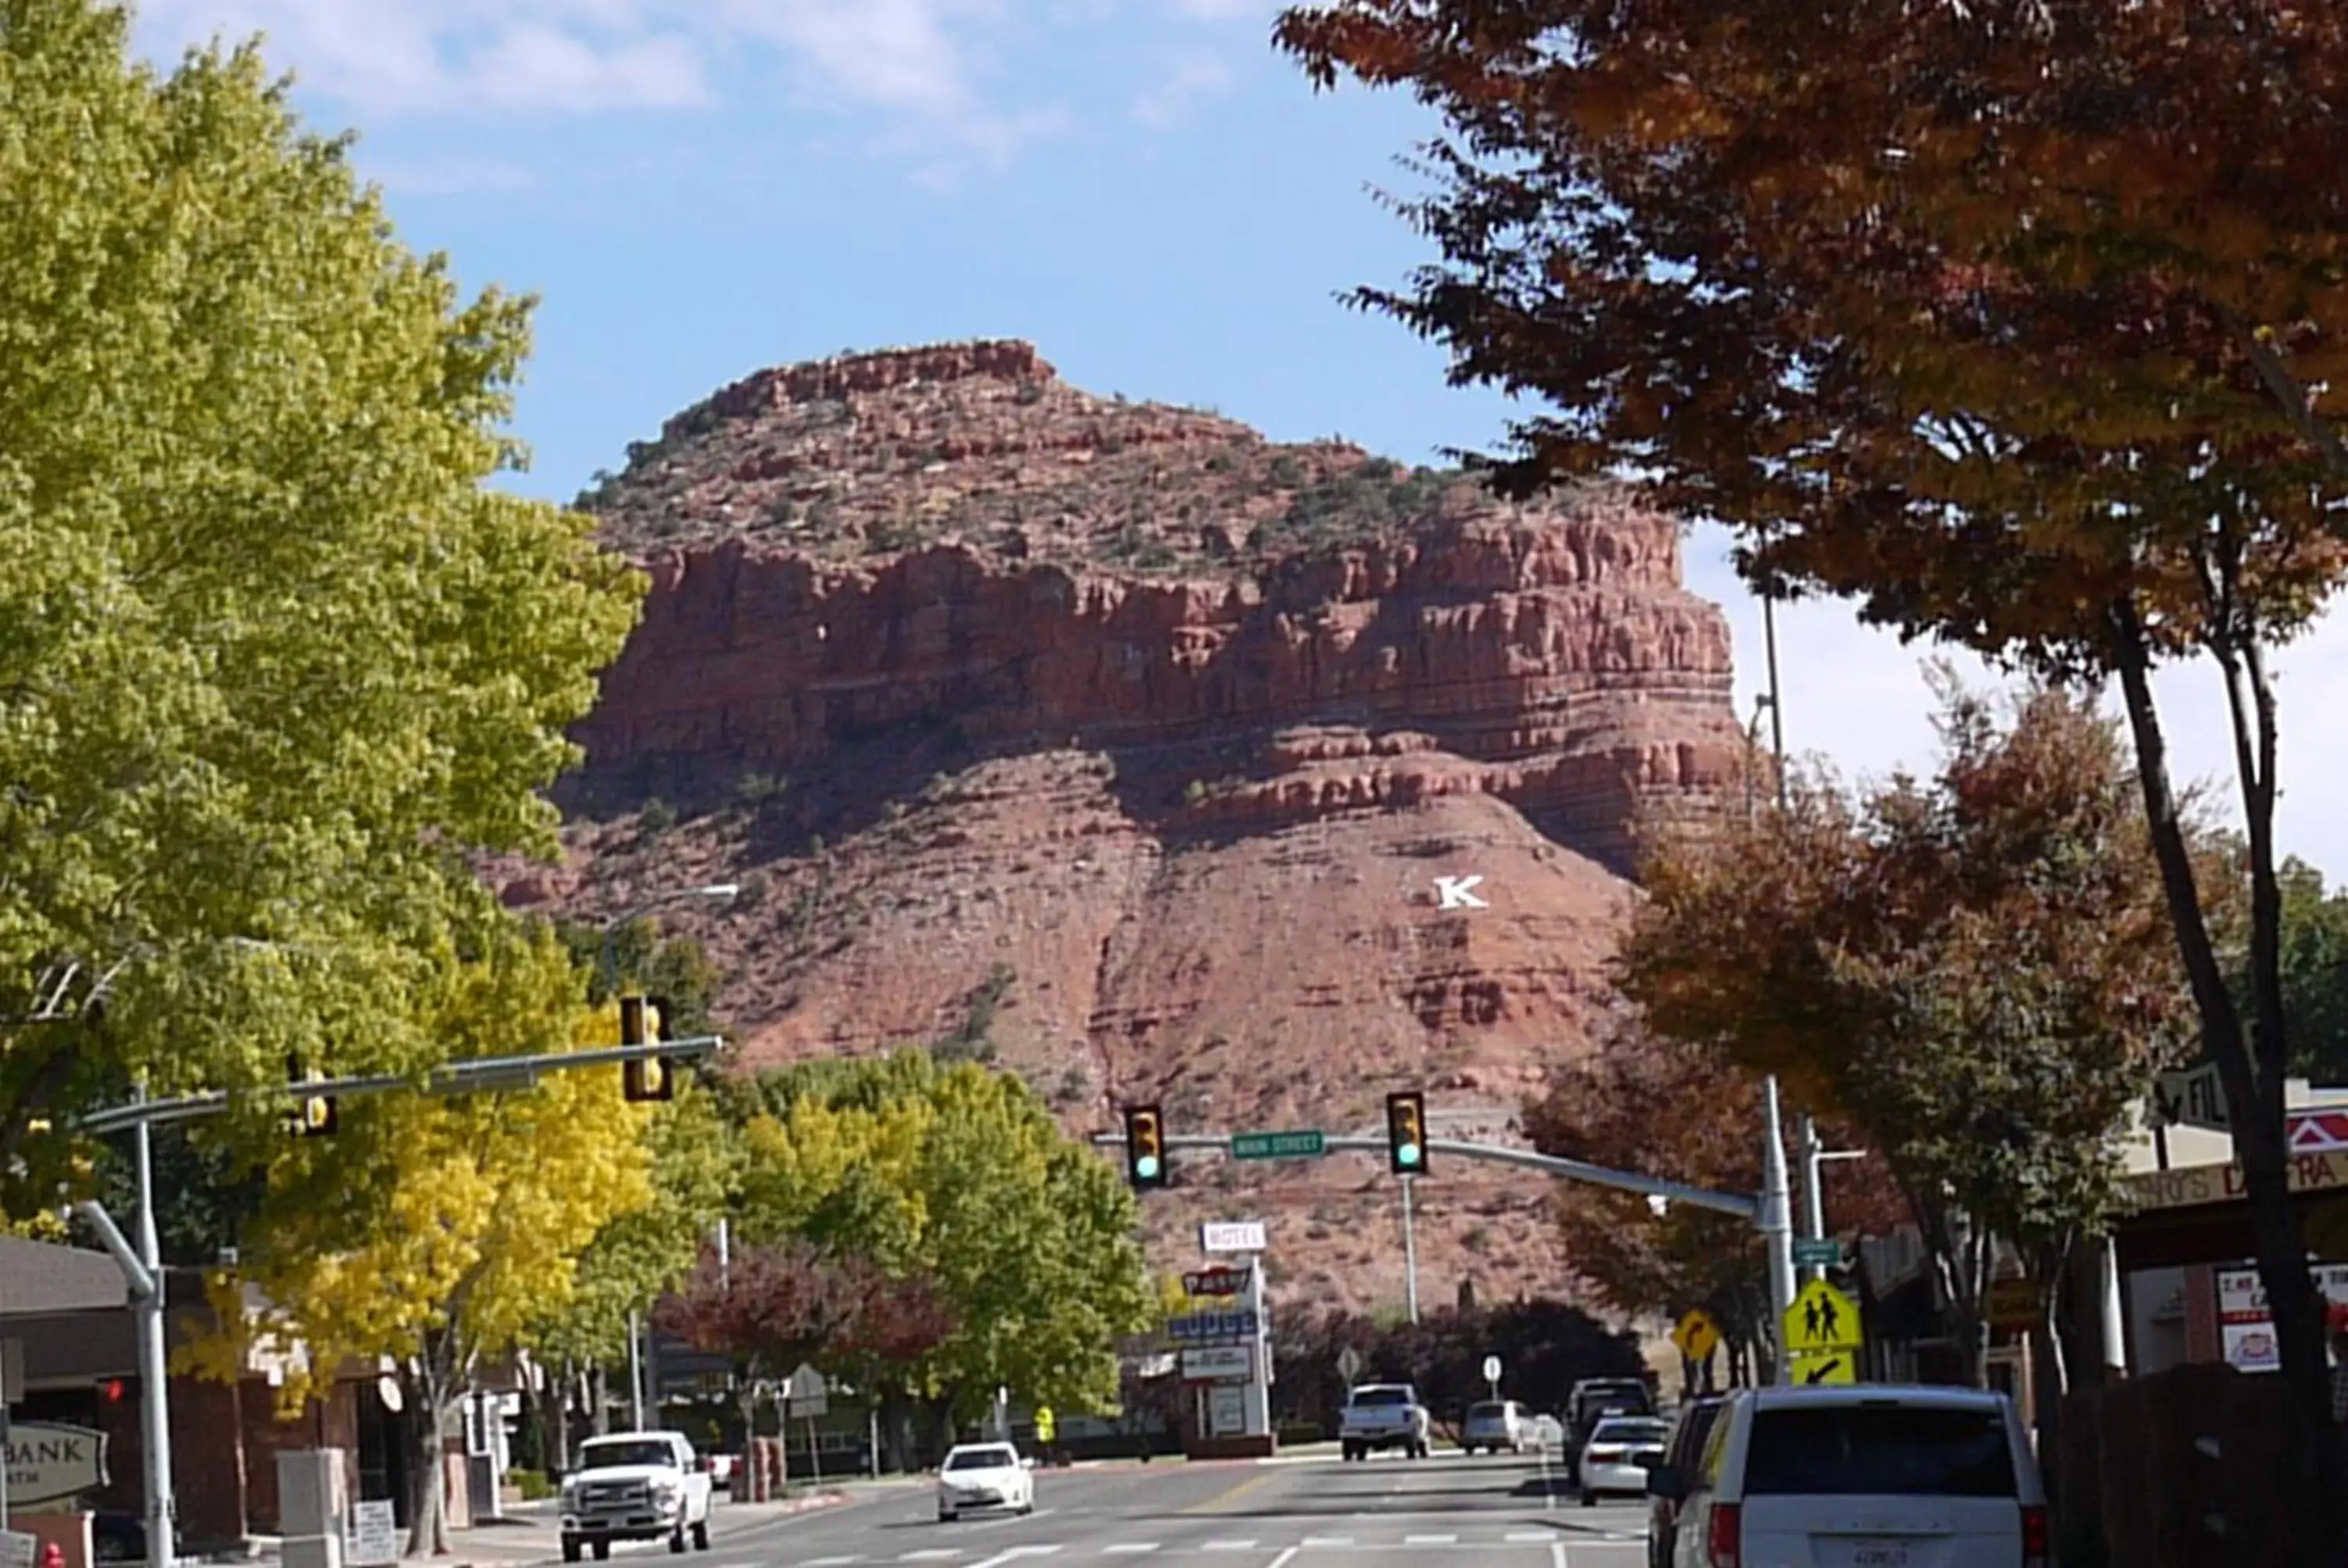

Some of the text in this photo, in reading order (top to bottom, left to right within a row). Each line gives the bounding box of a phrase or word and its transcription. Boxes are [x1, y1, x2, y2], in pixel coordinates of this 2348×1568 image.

[1433, 874, 1489, 909] K
[1272, 1135, 1318, 1153] STREET
[1209, 1228, 1259, 1245] MOTEL
